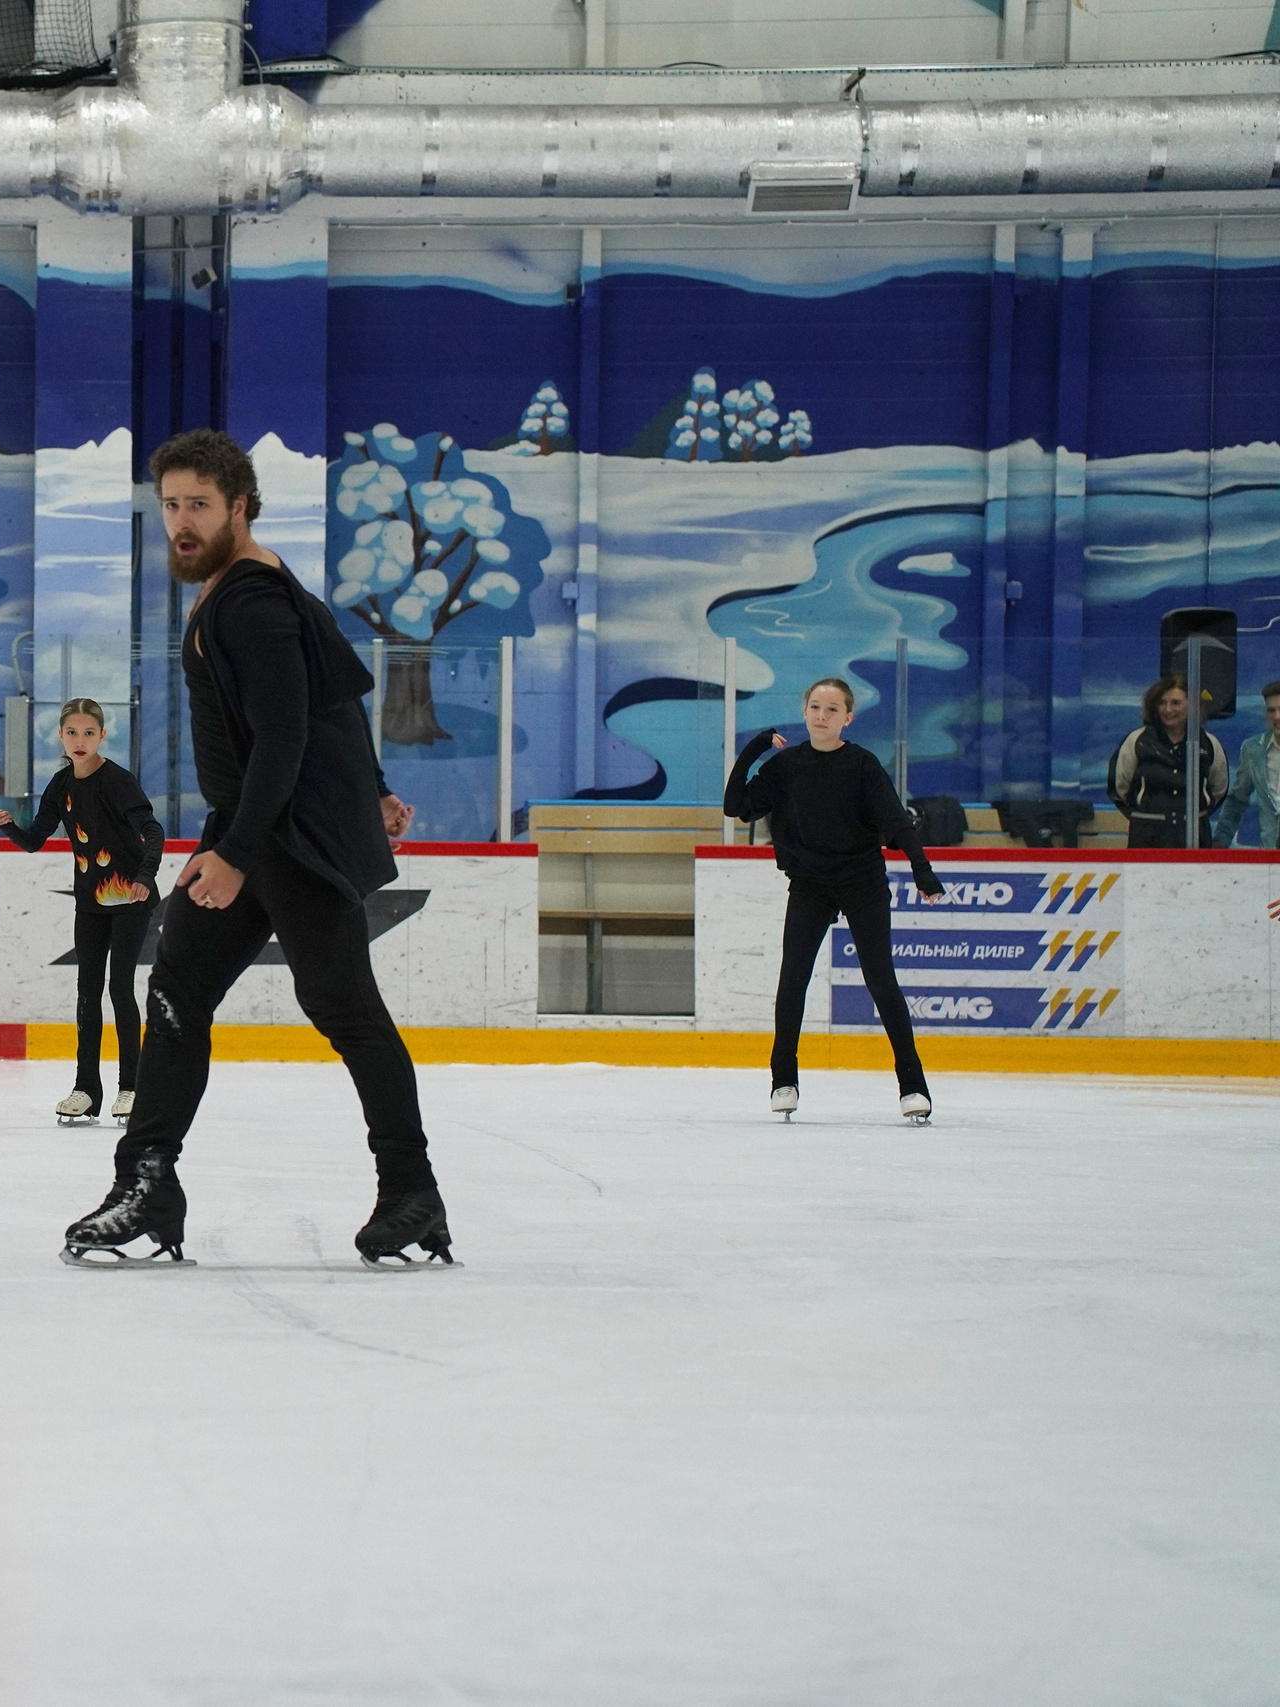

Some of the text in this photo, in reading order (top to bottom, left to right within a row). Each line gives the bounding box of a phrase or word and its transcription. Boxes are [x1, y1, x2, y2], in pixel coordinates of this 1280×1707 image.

[904, 881, 1014, 906] ТХНО
[843, 942, 1025, 960] ОИАЛЬНЫЙ ДИЛЕР
